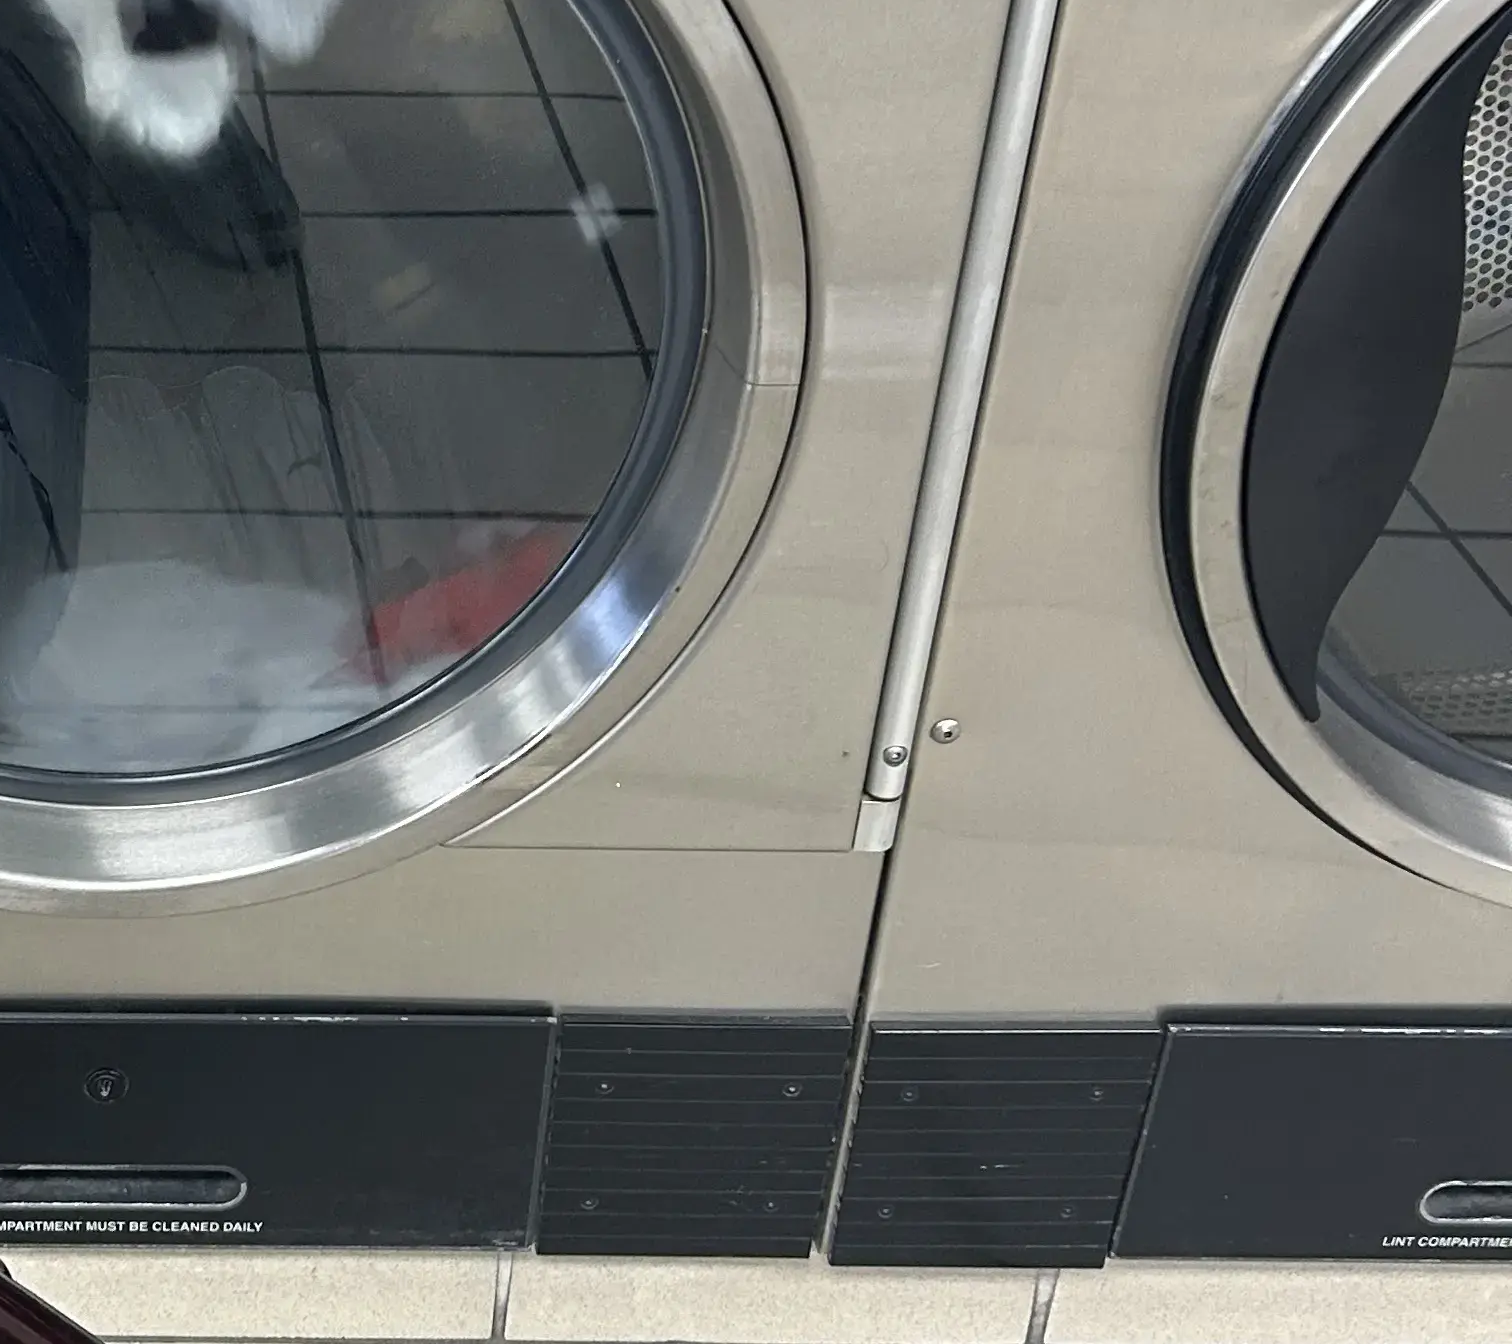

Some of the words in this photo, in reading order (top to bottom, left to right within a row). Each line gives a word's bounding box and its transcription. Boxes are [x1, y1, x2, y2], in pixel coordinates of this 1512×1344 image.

[86, 1221, 125, 1232] MUST
[130, 1222, 148, 1231] BE
[152, 1222, 219, 1232] CLEANED
[224, 1222, 262, 1232] DAILY
[1383, 1237, 1415, 1246] LINT
